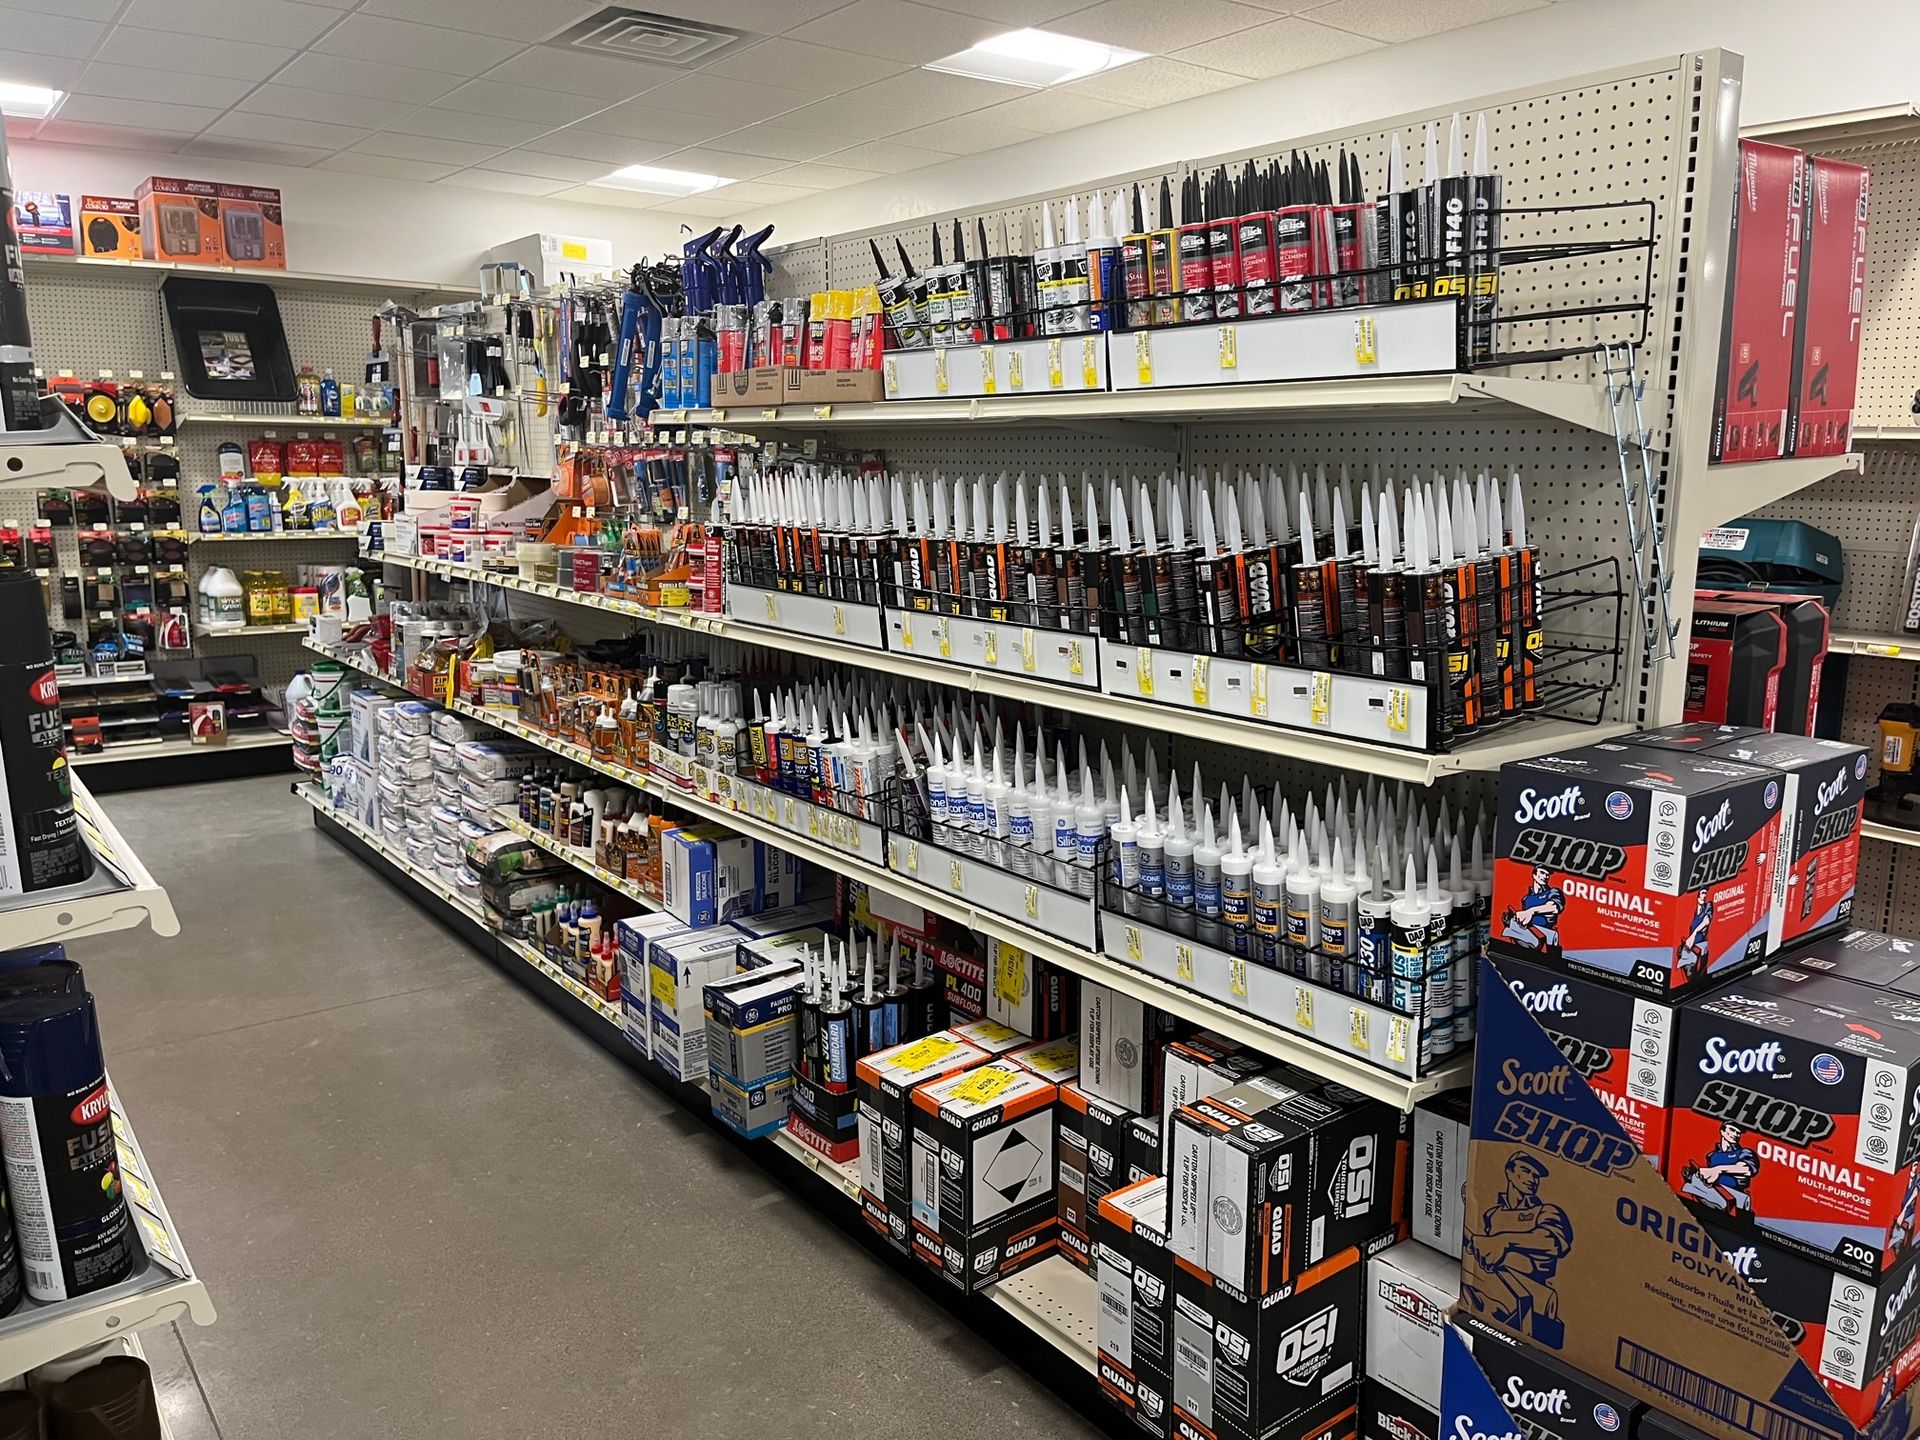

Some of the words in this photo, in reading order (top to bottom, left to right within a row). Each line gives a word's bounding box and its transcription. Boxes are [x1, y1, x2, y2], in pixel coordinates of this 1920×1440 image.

[1749, 152, 1758, 212] Milwaukee
[1792, 155, 1803, 208] M18
[1859, 172, 1870, 222] M18
[1786, 224, 1790, 236] TO
[1284, 252, 1308, 260] CEMENT
[949, 276, 961, 287] DAP
[1039, 266, 1051, 278] DAP
[1782, 213, 1800, 337] FUEL
[1850, 226, 1866, 342] FUEL
[883, 292, 894, 302] DAP
[928, 280, 938, 290] DAP
[912, 547, 921, 589] QUAD
[988, 554, 998, 600] QUAD
[1249, 562, 1271, 616] QUAD
[1695, 619, 1729, 628] LITHIUM
[434, 676, 447, 684] ZIP
[753, 729, 767, 766] PREMIUM
[809, 749, 819, 773] 300
[1814, 766, 1847, 816] Scott
[1515, 786, 1581, 824] Scott
[1692, 799, 1730, 853] Scott
[1810, 804, 1858, 849] SHOP
[1510, 828, 1626, 879] SHOP
[1688, 840, 1749, 889] SHOP
[1563, 879, 1655, 915] ORIGINAL
[1713, 884, 1746, 903] ORIGINAL
[1597, 907, 1660, 929] MULTI-PURPOSE
[1839, 900, 1851, 914] 200
[1360, 917, 1374, 927] DAP
[1408, 930, 1425, 943] DAP
[1748, 939, 1761, 953] 200
[940, 951, 985, 982] LOCTITE
[1006, 954, 1015, 978] 4036
[1637, 965, 1664, 983] 200
[945, 974, 959, 992] PL
[961, 982, 981, 1002] 400
[1050, 975, 1059, 1013] QUAD
[777, 1003, 793, 1014] PRO
[947, 992, 982, 1015] SUBFLOOR
[1700, 1004, 1763, 1025] ORIGINAL
[1721, 994, 1779, 1010] Scott
[830, 1023, 840, 1081] FOAMBOARD
[1700, 1037, 1781, 1074] Scott
[1497, 1058, 1571, 1096] Scott
[1772, 1071, 1793, 1080] Brand
[881, 1081, 900, 1099] QUAD
[940, 1109, 962, 1129] QUAD
[972, 1114, 999, 1132] QUAD
[1089, 1107, 1112, 1126] QUAD
[1197, 1105, 1240, 1126] QUAD
[1692, 1080, 1836, 1146] SHOP
[792, 1119, 832, 1155] LOCTITE
[882, 1122, 903, 1144] OSI
[1133, 1129, 1158, 1148] QUAD
[1243, 1124, 1284, 1143] OSI
[1435, 1130, 1443, 1160] CARTON
[1494, 1100, 1640, 1178] SHOP
[940, 1148, 964, 1173] OSI
[1089, 1148, 1114, 1171] OSI
[1756, 1141, 1866, 1192] ORIGINAL
[1277, 1153, 1291, 1192] OSI
[1340, 1159, 1348, 1201] TOUGHER
[1346, 1135, 1373, 1219] OSI
[1435, 1161, 1443, 1189] SHIPPED
[1425, 1173, 1433, 1205] DISPLAY
[1798, 1176, 1871, 1207] MULTI-PURPOSE
[866, 1202, 888, 1224] QUAD
[1425, 1206, 1433, 1217] USE
[1435, 1190, 1443, 1216] UPSIDE
[889, 1213, 906, 1235] OSI
[1135, 1224, 1165, 1248] QUAD
[1271, 1206, 1283, 1255] QUAD
[1434, 1217, 1442, 1238] DOWN
[916, 1232, 942, 1257] QUAD
[1005, 1236, 1036, 1258] QUAD
[1062, 1230, 1088, 1254] QUAD
[1368, 1234, 1395, 1254] QUAD
[1843, 1243, 1874, 1264] 200
[943, 1247, 965, 1268] OSI
[974, 1248, 998, 1270] OSI
[1133, 1269, 1166, 1301] OSI
[1215, 1278, 1248, 1304] QUAD
[1379, 1280, 1415, 1314] Black
[1262, 1286, 1292, 1310] QUAD
[1667, 1276, 1705, 1297] Absorbe
[1737, 1305, 1748, 1317] et
[1749, 1308, 1758, 1320] la
[1469, 1319, 1518, 1347] ORIGINAL
[1688, 1299, 1716, 1320] même
[1718, 1315, 1735, 1328] une
[1737, 1321, 1754, 1337] fois
[1756, 1331, 1791, 1352] mouillé
[1216, 1324, 1250, 1360] OSI
[1276, 1308, 1338, 1375] OSI
[1288, 1355, 1319, 1377] TOUGHER
[1102, 1364, 1135, 1395] QUAD
[1137, 1385, 1164, 1413] OSI
[1502, 1375, 1568, 1415] Scott
